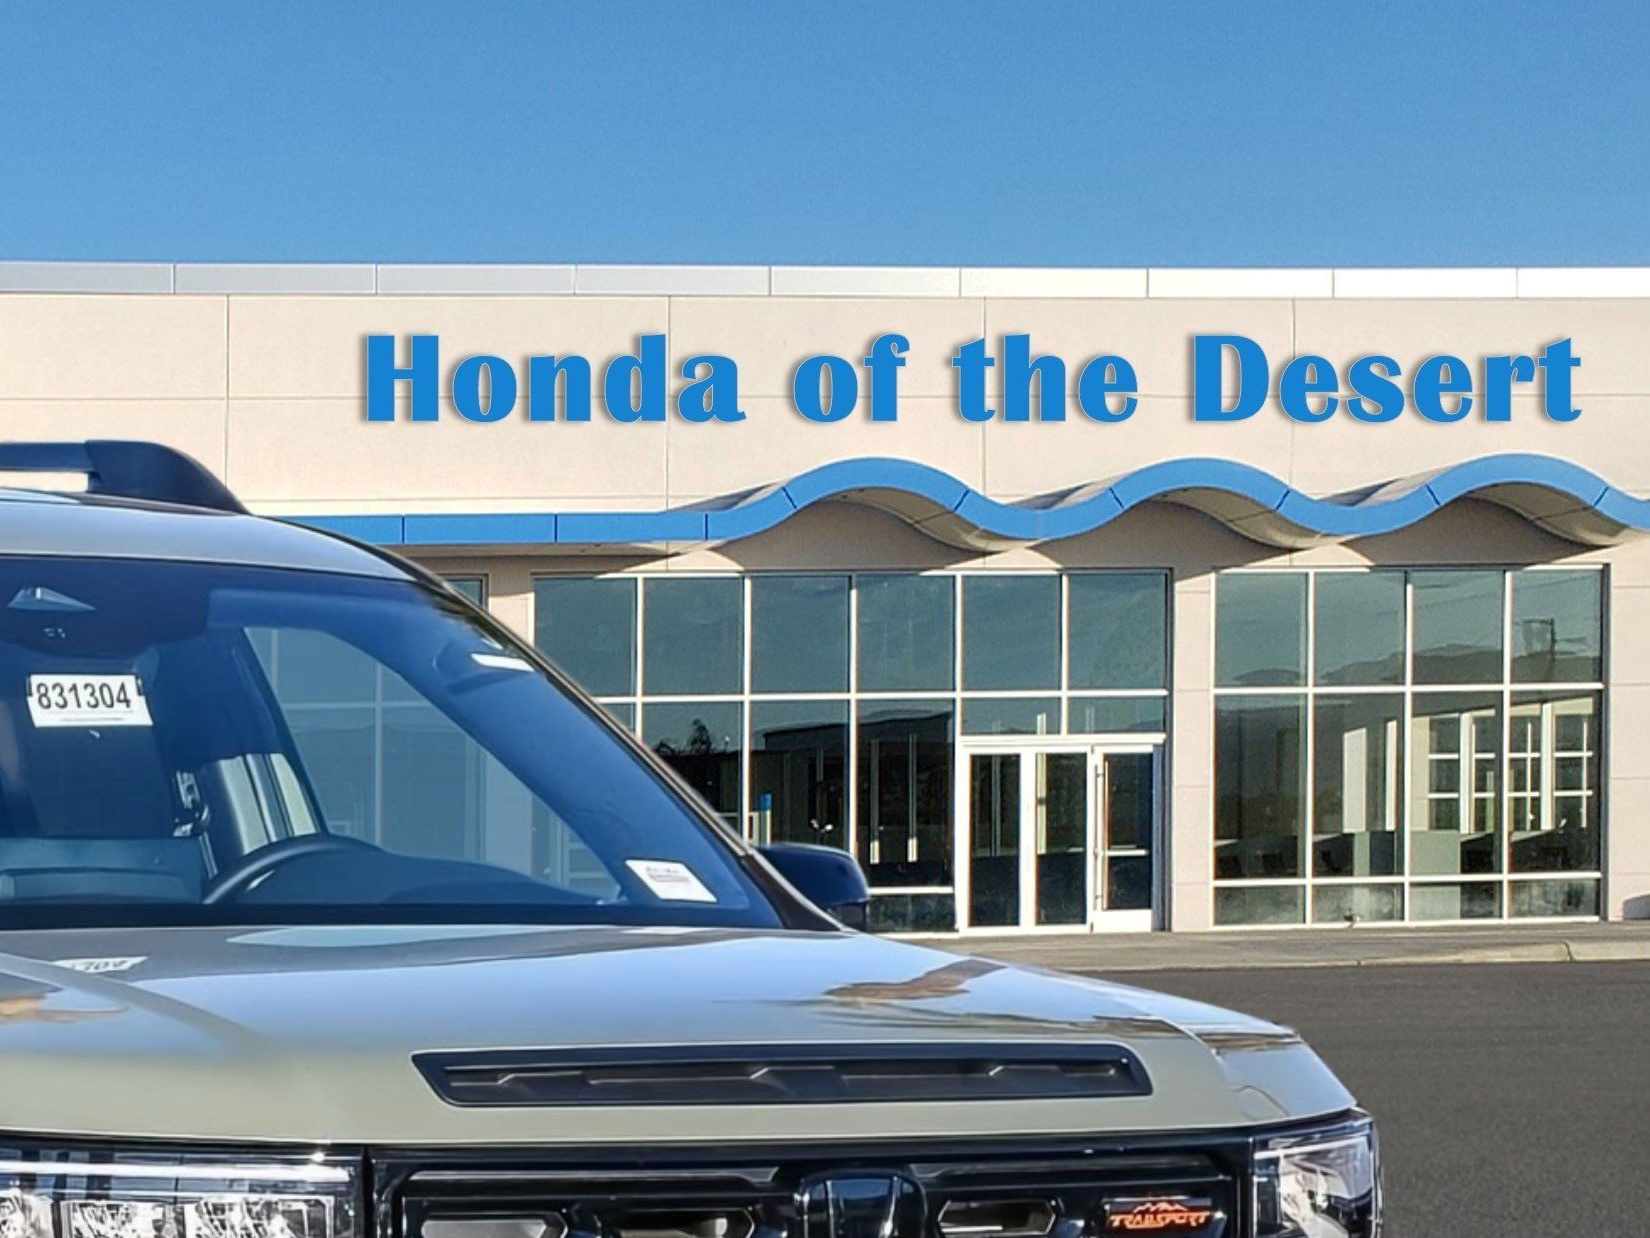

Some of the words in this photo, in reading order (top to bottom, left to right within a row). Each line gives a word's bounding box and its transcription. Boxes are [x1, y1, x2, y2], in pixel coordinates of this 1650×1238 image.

[366, 332, 747, 423] Honda
[792, 332, 910, 423] of
[951, 332, 1139, 424] the
[1192, 333, 1584, 424] Desert
[35, 681, 132, 709] 831304
